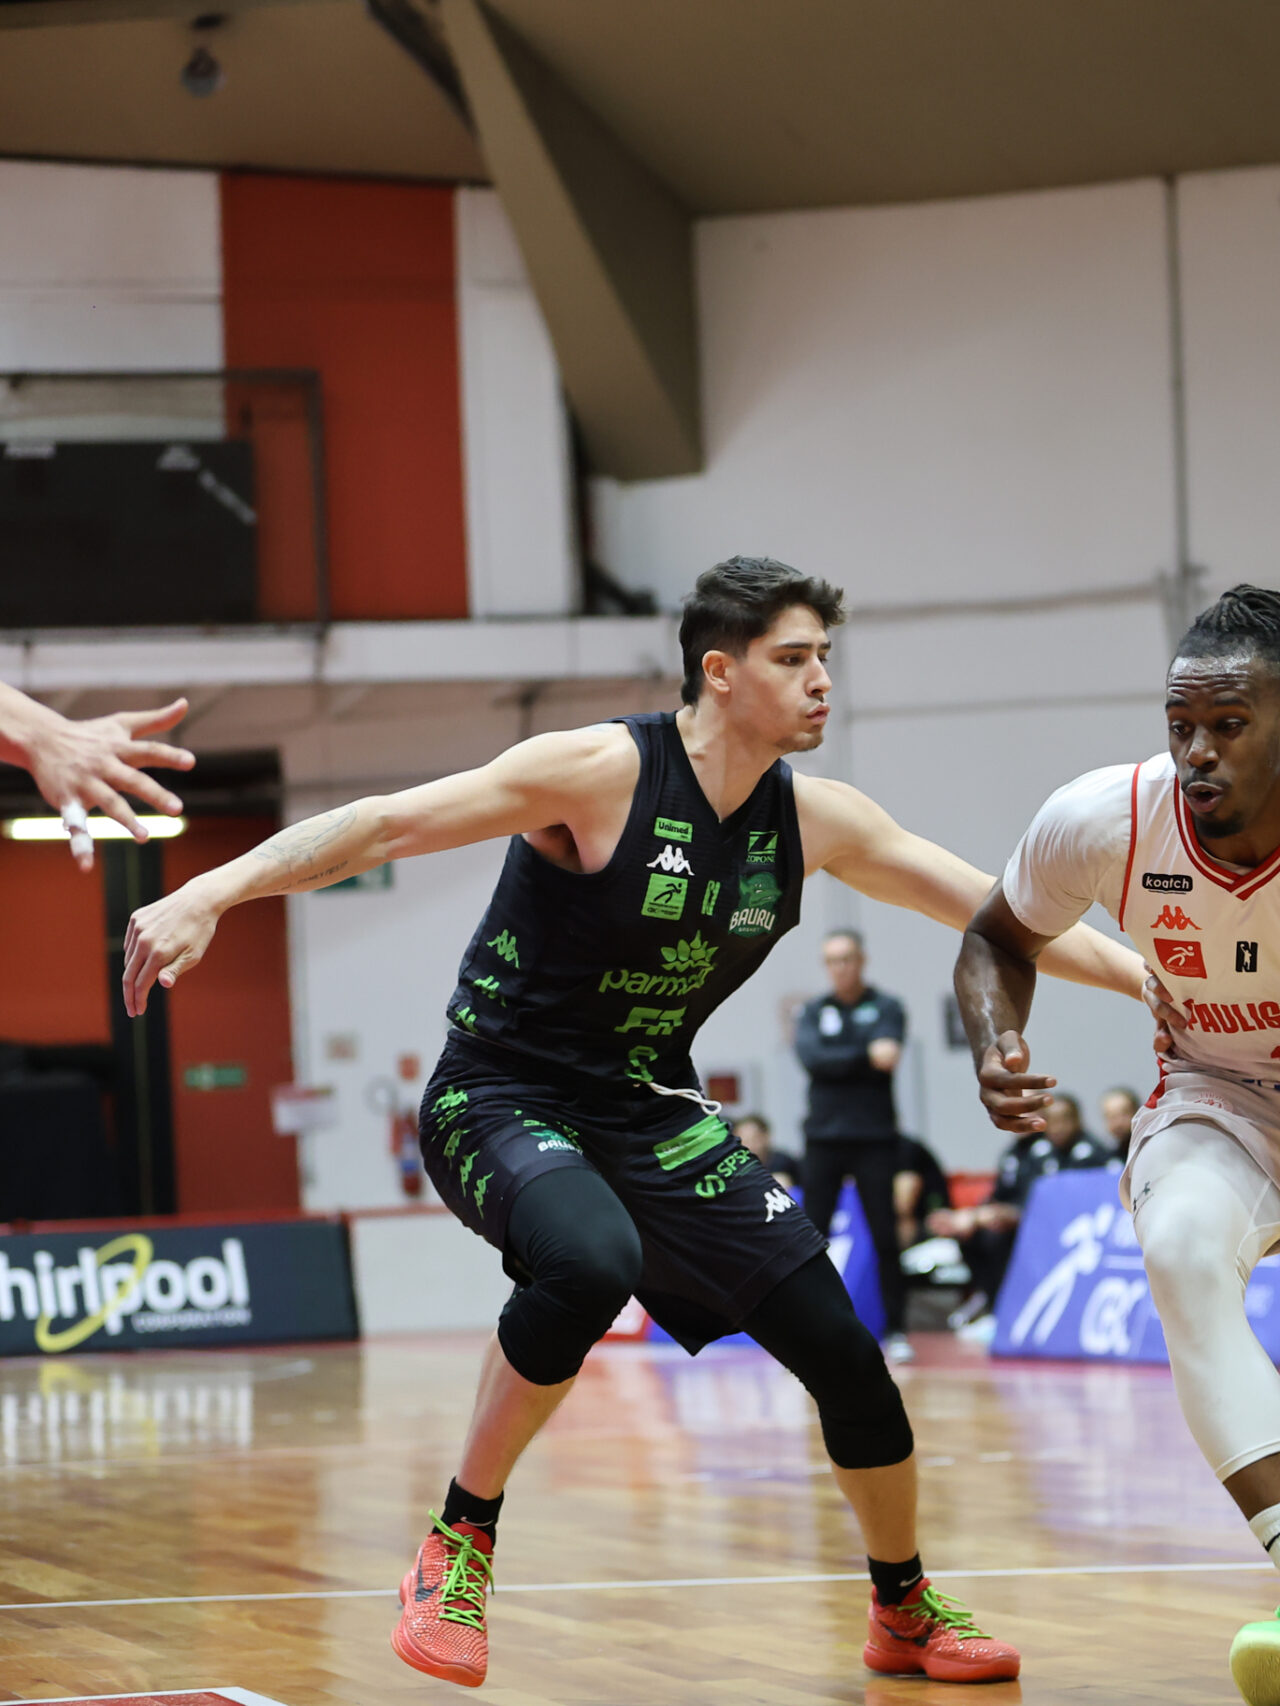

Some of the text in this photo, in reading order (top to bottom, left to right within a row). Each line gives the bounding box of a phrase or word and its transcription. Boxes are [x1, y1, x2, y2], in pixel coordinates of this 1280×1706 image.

[658, 821, 689, 835] Unimed
[1145, 875, 1190, 890] koatch
[729, 907, 776, 931] BAURU
